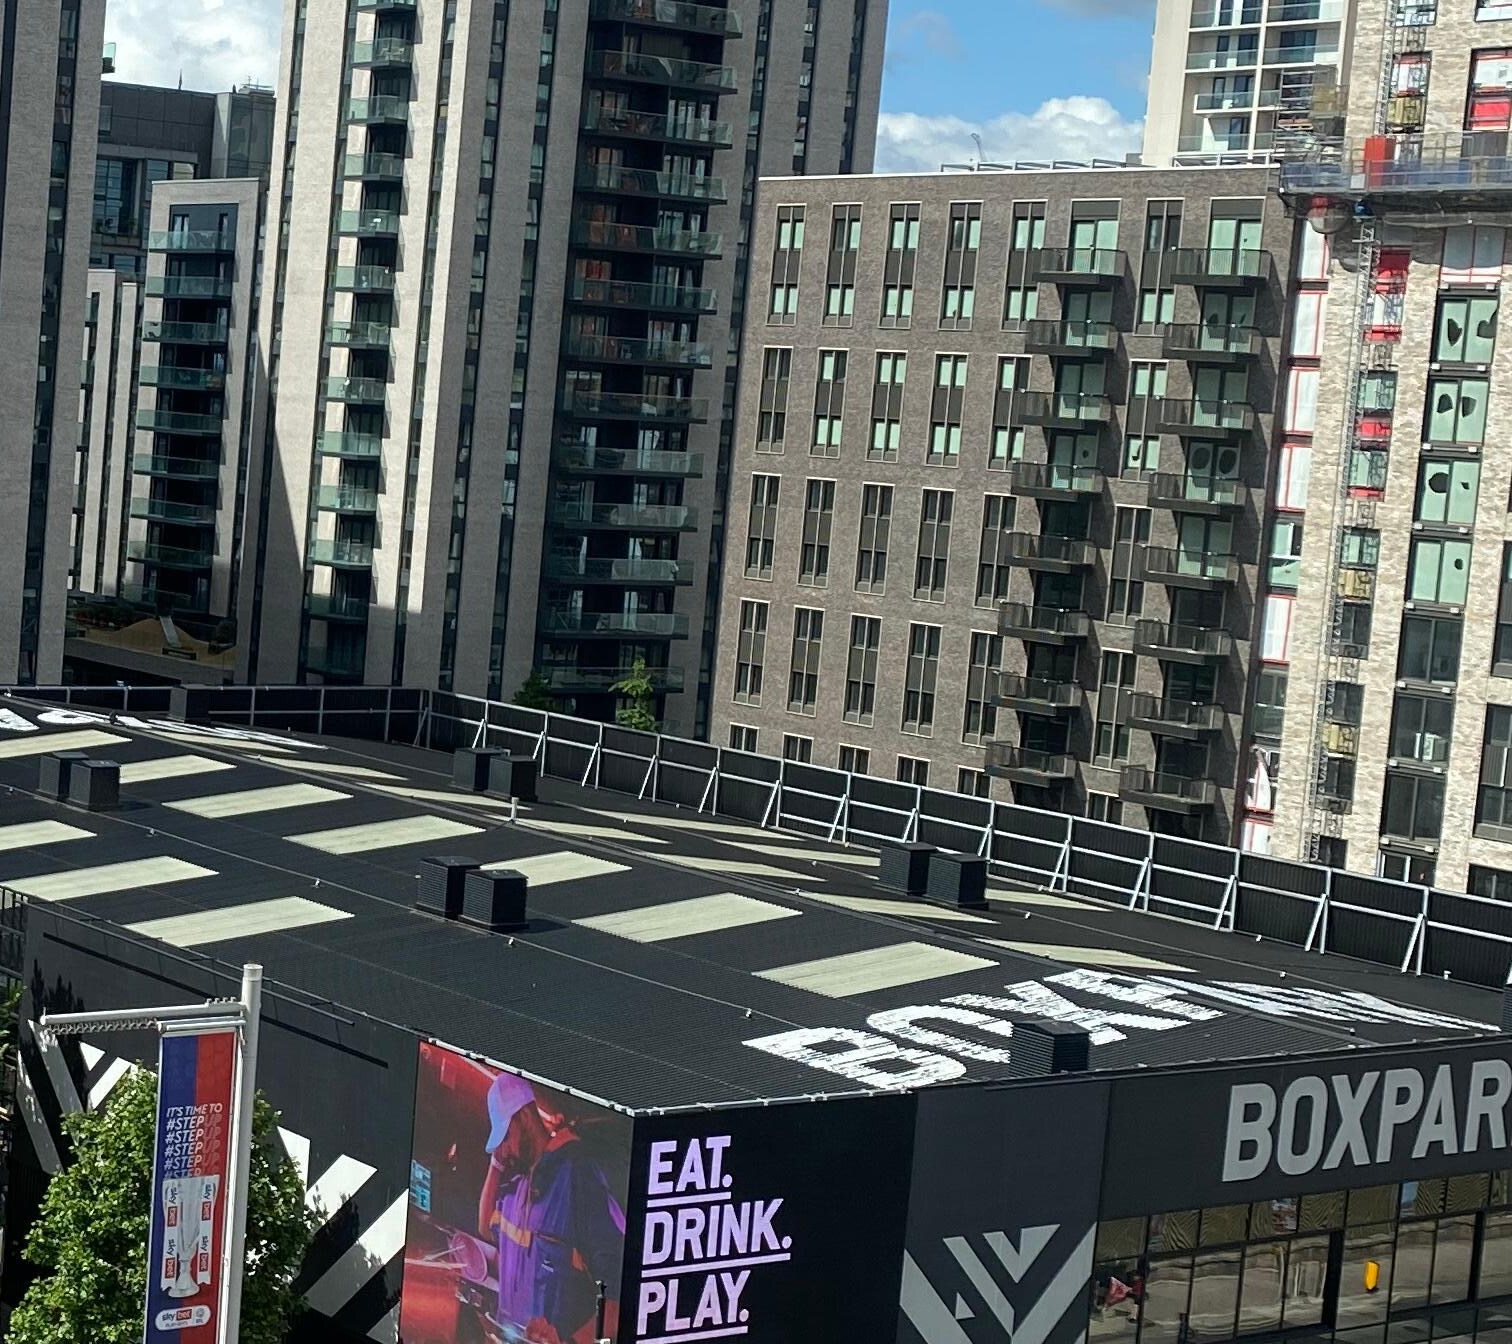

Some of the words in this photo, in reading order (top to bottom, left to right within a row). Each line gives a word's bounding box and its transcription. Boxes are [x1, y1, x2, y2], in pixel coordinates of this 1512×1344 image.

[167, 1106, 183, 1117] IT'S
[185, 1104, 208, 1115] TIME
[209, 1103, 223, 1113] TO
[1223, 1059, 1512, 1182] BOXPAR
[648, 1136, 733, 1195] EAT.
[643, 1198, 792, 1265] DRINK.
[162, 1312, 176, 1322] sky
[177, 1310, 192, 1319] bet
[637, 1270, 751, 1335] PLAY.
